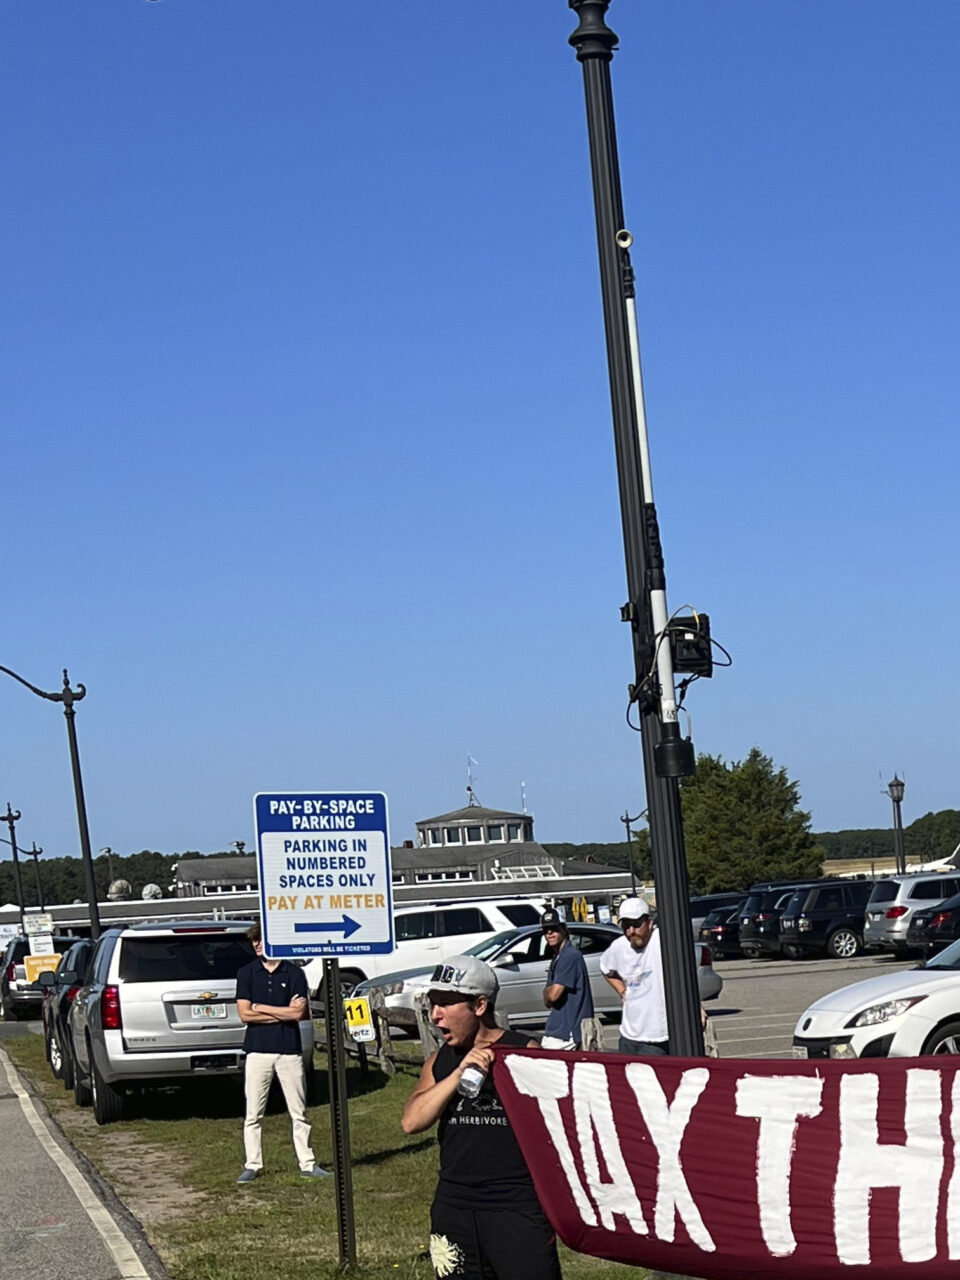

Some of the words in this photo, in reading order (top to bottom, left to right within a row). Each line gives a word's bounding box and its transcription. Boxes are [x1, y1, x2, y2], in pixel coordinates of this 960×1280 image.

[269, 800, 375, 814] PAY-BY-SPACE
[292, 815, 355, 830] PARKING
[284, 840, 348, 853] PARKING
[353, 839, 367, 852] IN
[286, 856, 366, 870] NUMBERED
[279, 875, 334, 888] SPACES
[338, 873, 376, 887] ONLY
[268, 896, 298, 910] PAY
[304, 895, 324, 909] AT
[330, 894, 385, 909] METER
[346, 1004, 364, 1020] 11
[459, 1115, 508, 1126] HERBIVORE
[504, 1054, 716, 1253] TAX
